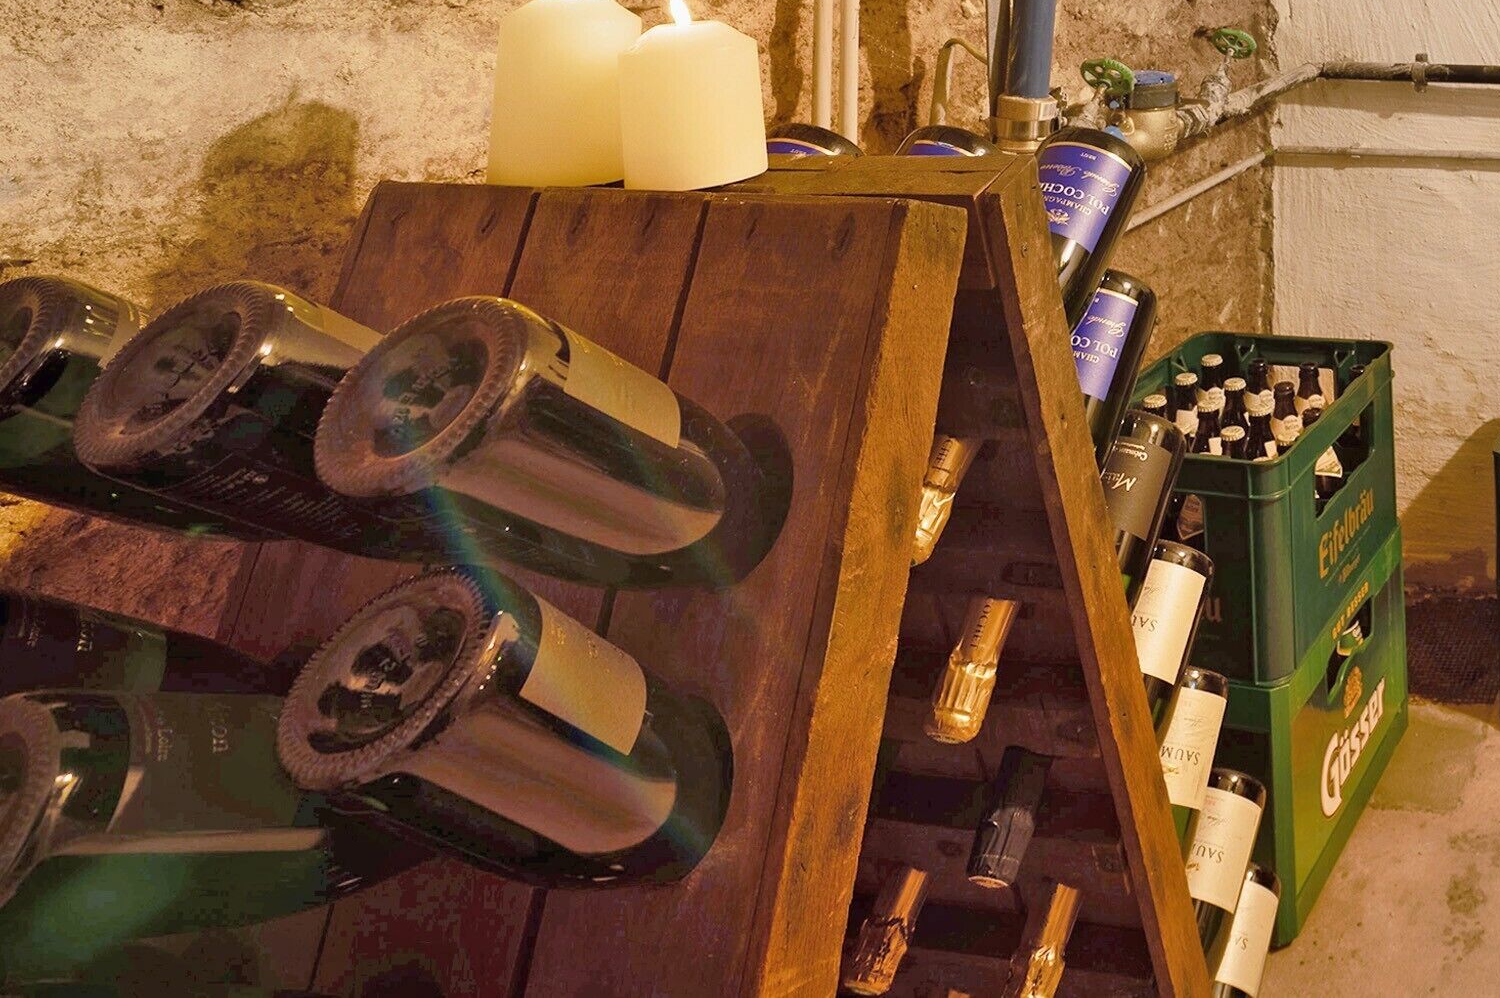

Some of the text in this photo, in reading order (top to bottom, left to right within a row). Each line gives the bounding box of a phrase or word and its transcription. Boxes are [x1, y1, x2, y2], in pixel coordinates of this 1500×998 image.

[1041, 195, 1092, 216] CHAMPAGN
[1088, 194, 1110, 215] POL
[1093, 340, 1119, 358] POL
[1319, 487, 1374, 579] Eifelbräu
[1320, 676, 1385, 817] Gösser
